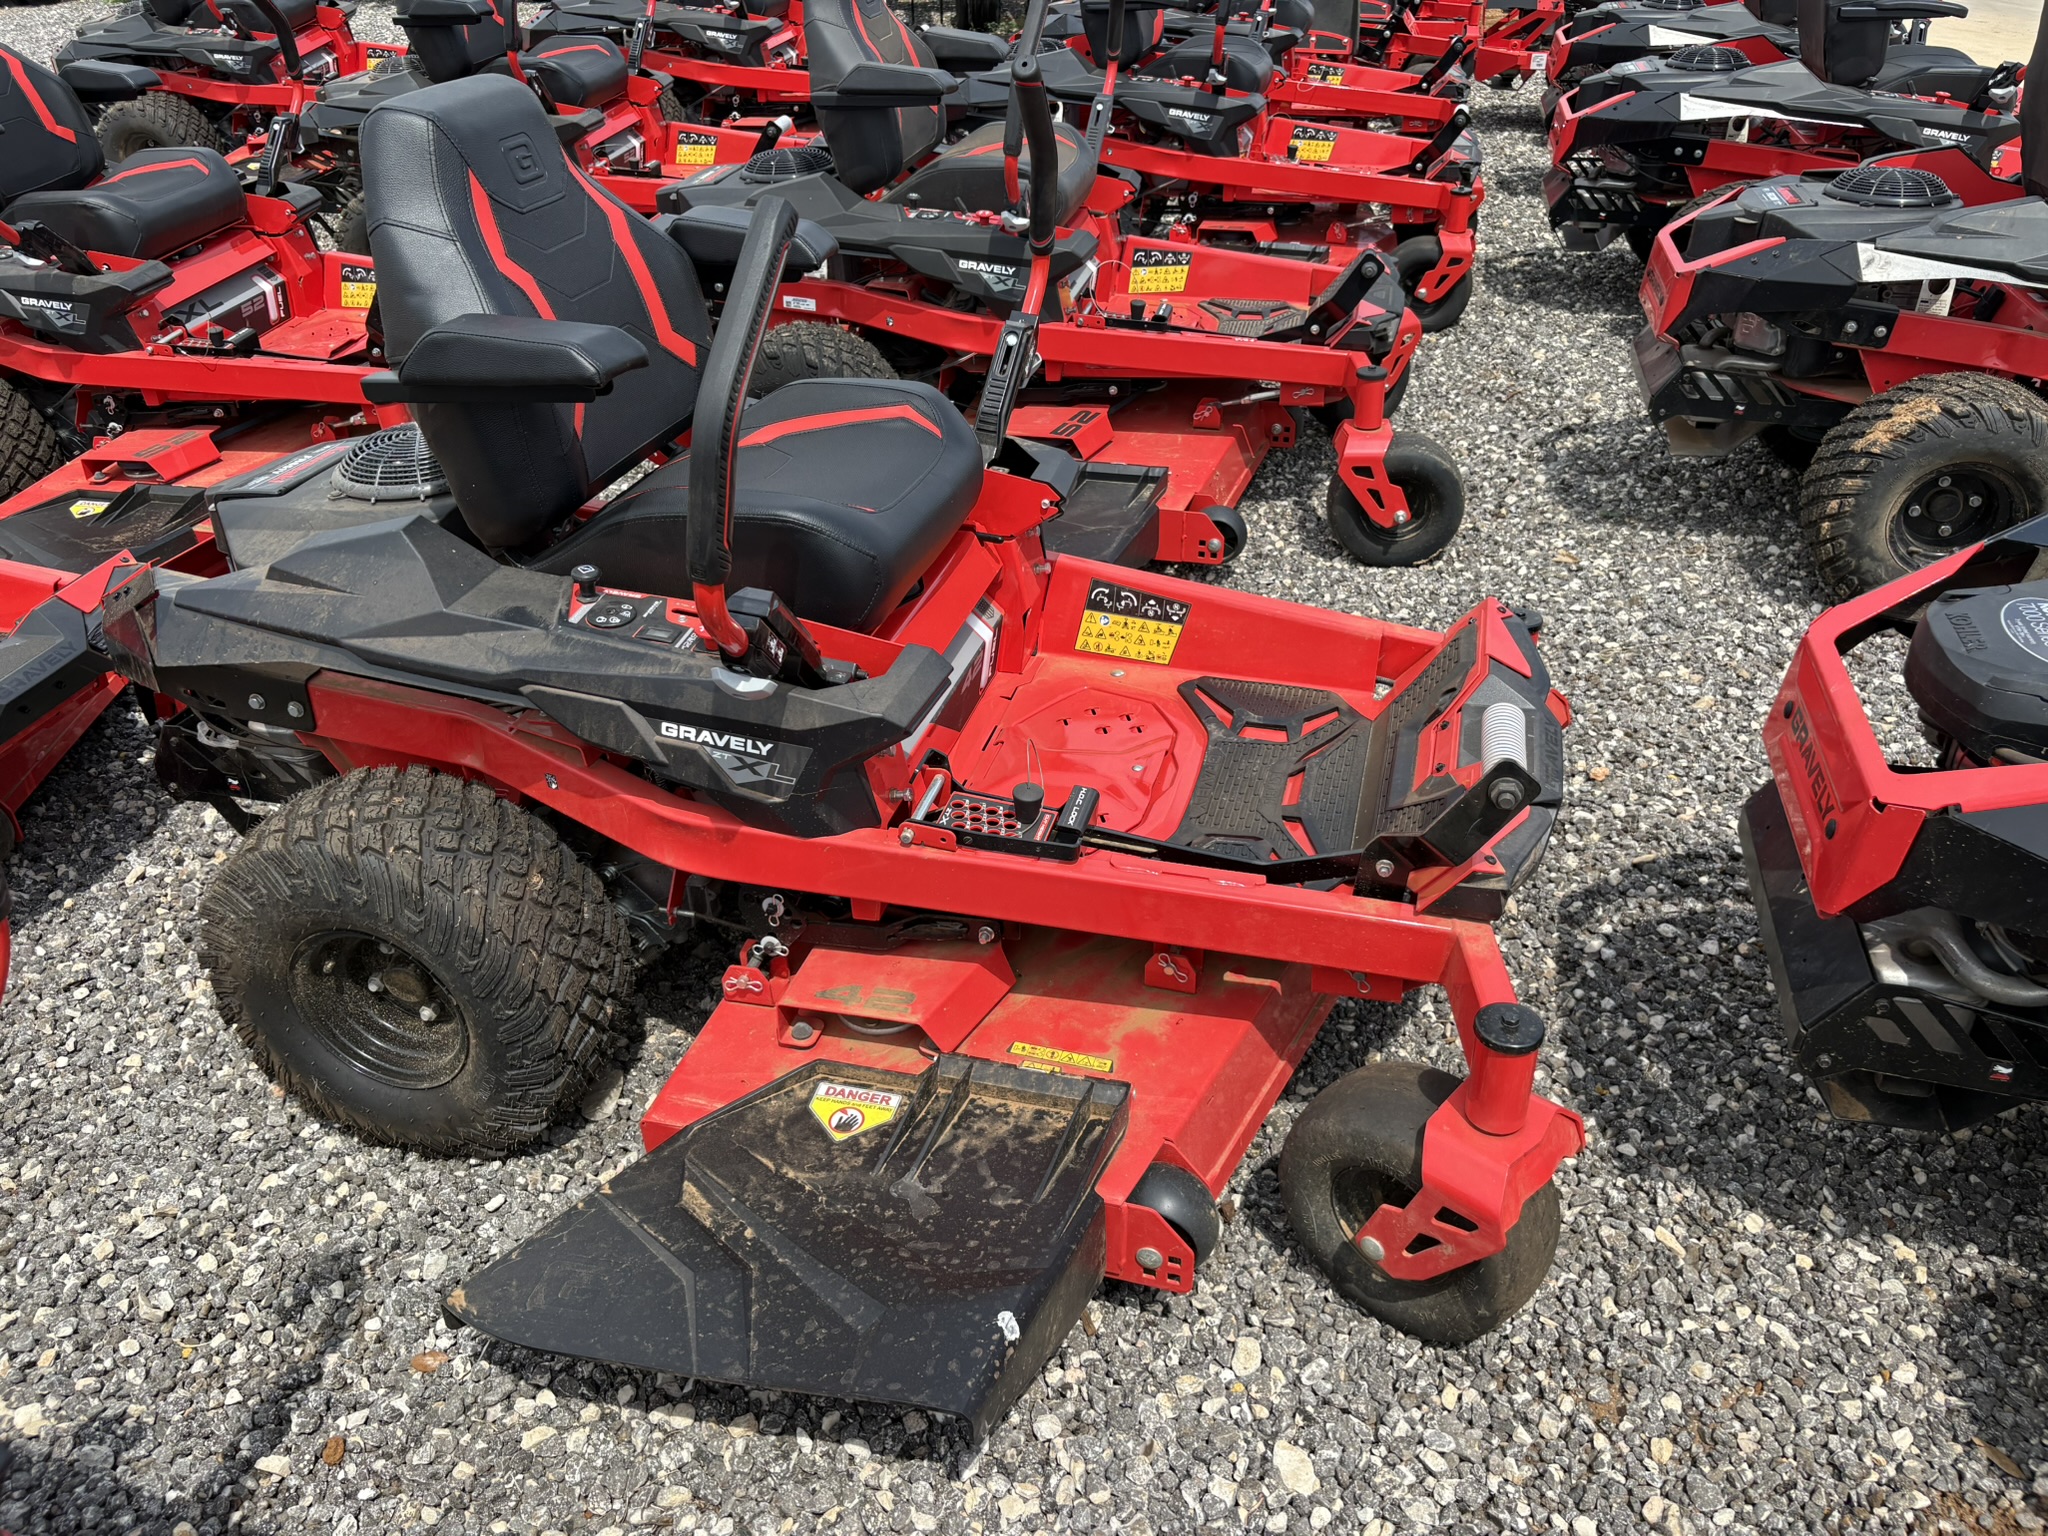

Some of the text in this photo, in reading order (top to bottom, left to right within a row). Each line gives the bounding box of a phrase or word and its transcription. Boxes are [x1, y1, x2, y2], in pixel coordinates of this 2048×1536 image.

[706, 30, 738, 40] GRAVELY
[1168, 108, 1211, 122] GRAVELY
[1922, 127, 1971, 143] GRAVELY
[958, 259, 1016, 275] GRAVELY
[20, 296, 72, 311] GRAVELY
[241, 295, 265, 318] 52
[55, 311, 87, 325] XL
[1049, 410, 1101, 438] 52
[1944, 612, 1988, 655] KOHLER
[661, 721, 774, 756] GRAVELY
[711, 750, 797, 785] ZT XL
[1792, 706, 1835, 821] GRAVELY
[1067, 805, 1080, 826] LOCK
[814, 984, 917, 1013] 42
[824, 1085, 892, 1106] DANGER
